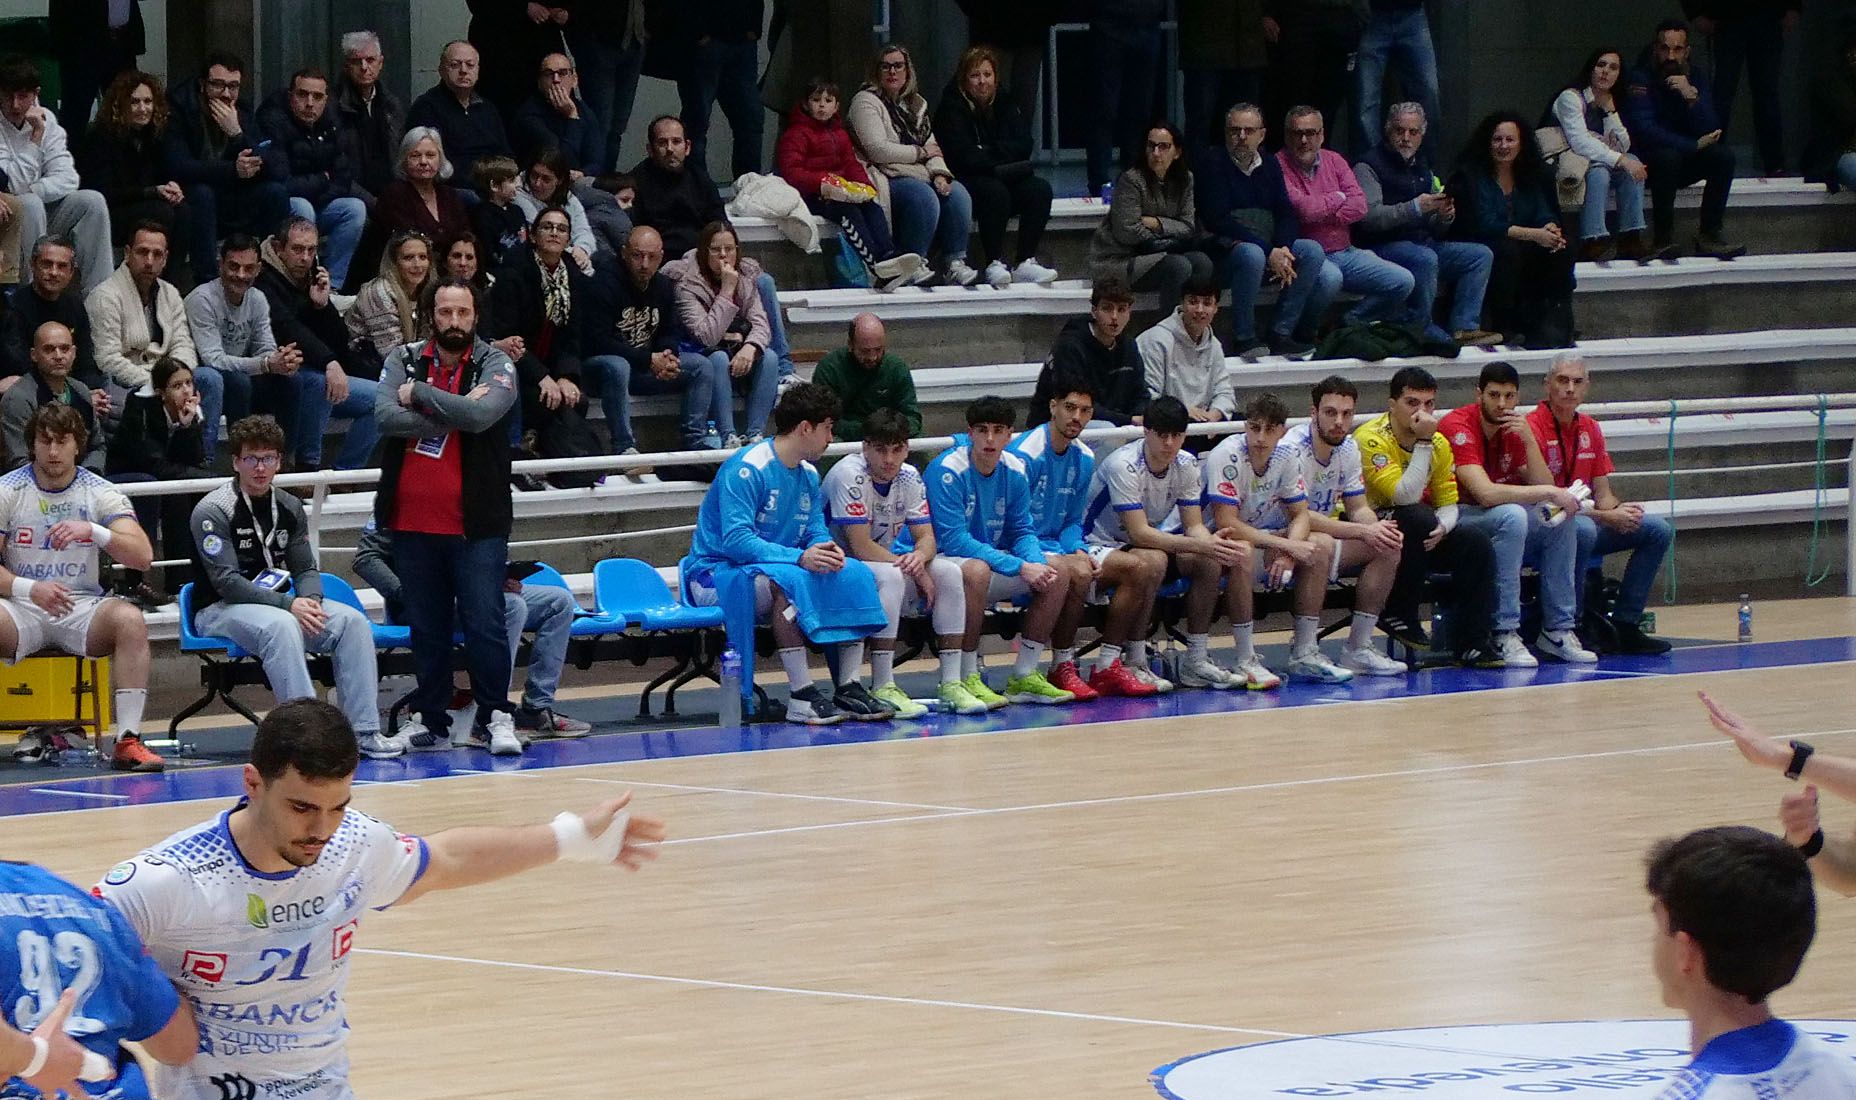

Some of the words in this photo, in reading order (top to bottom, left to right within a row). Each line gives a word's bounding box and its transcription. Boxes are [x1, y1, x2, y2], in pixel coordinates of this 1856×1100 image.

[271, 895, 326, 924] ence
[14, 928, 108, 1037] 92
[1274, 1047, 1694, 1097] ontevedra
